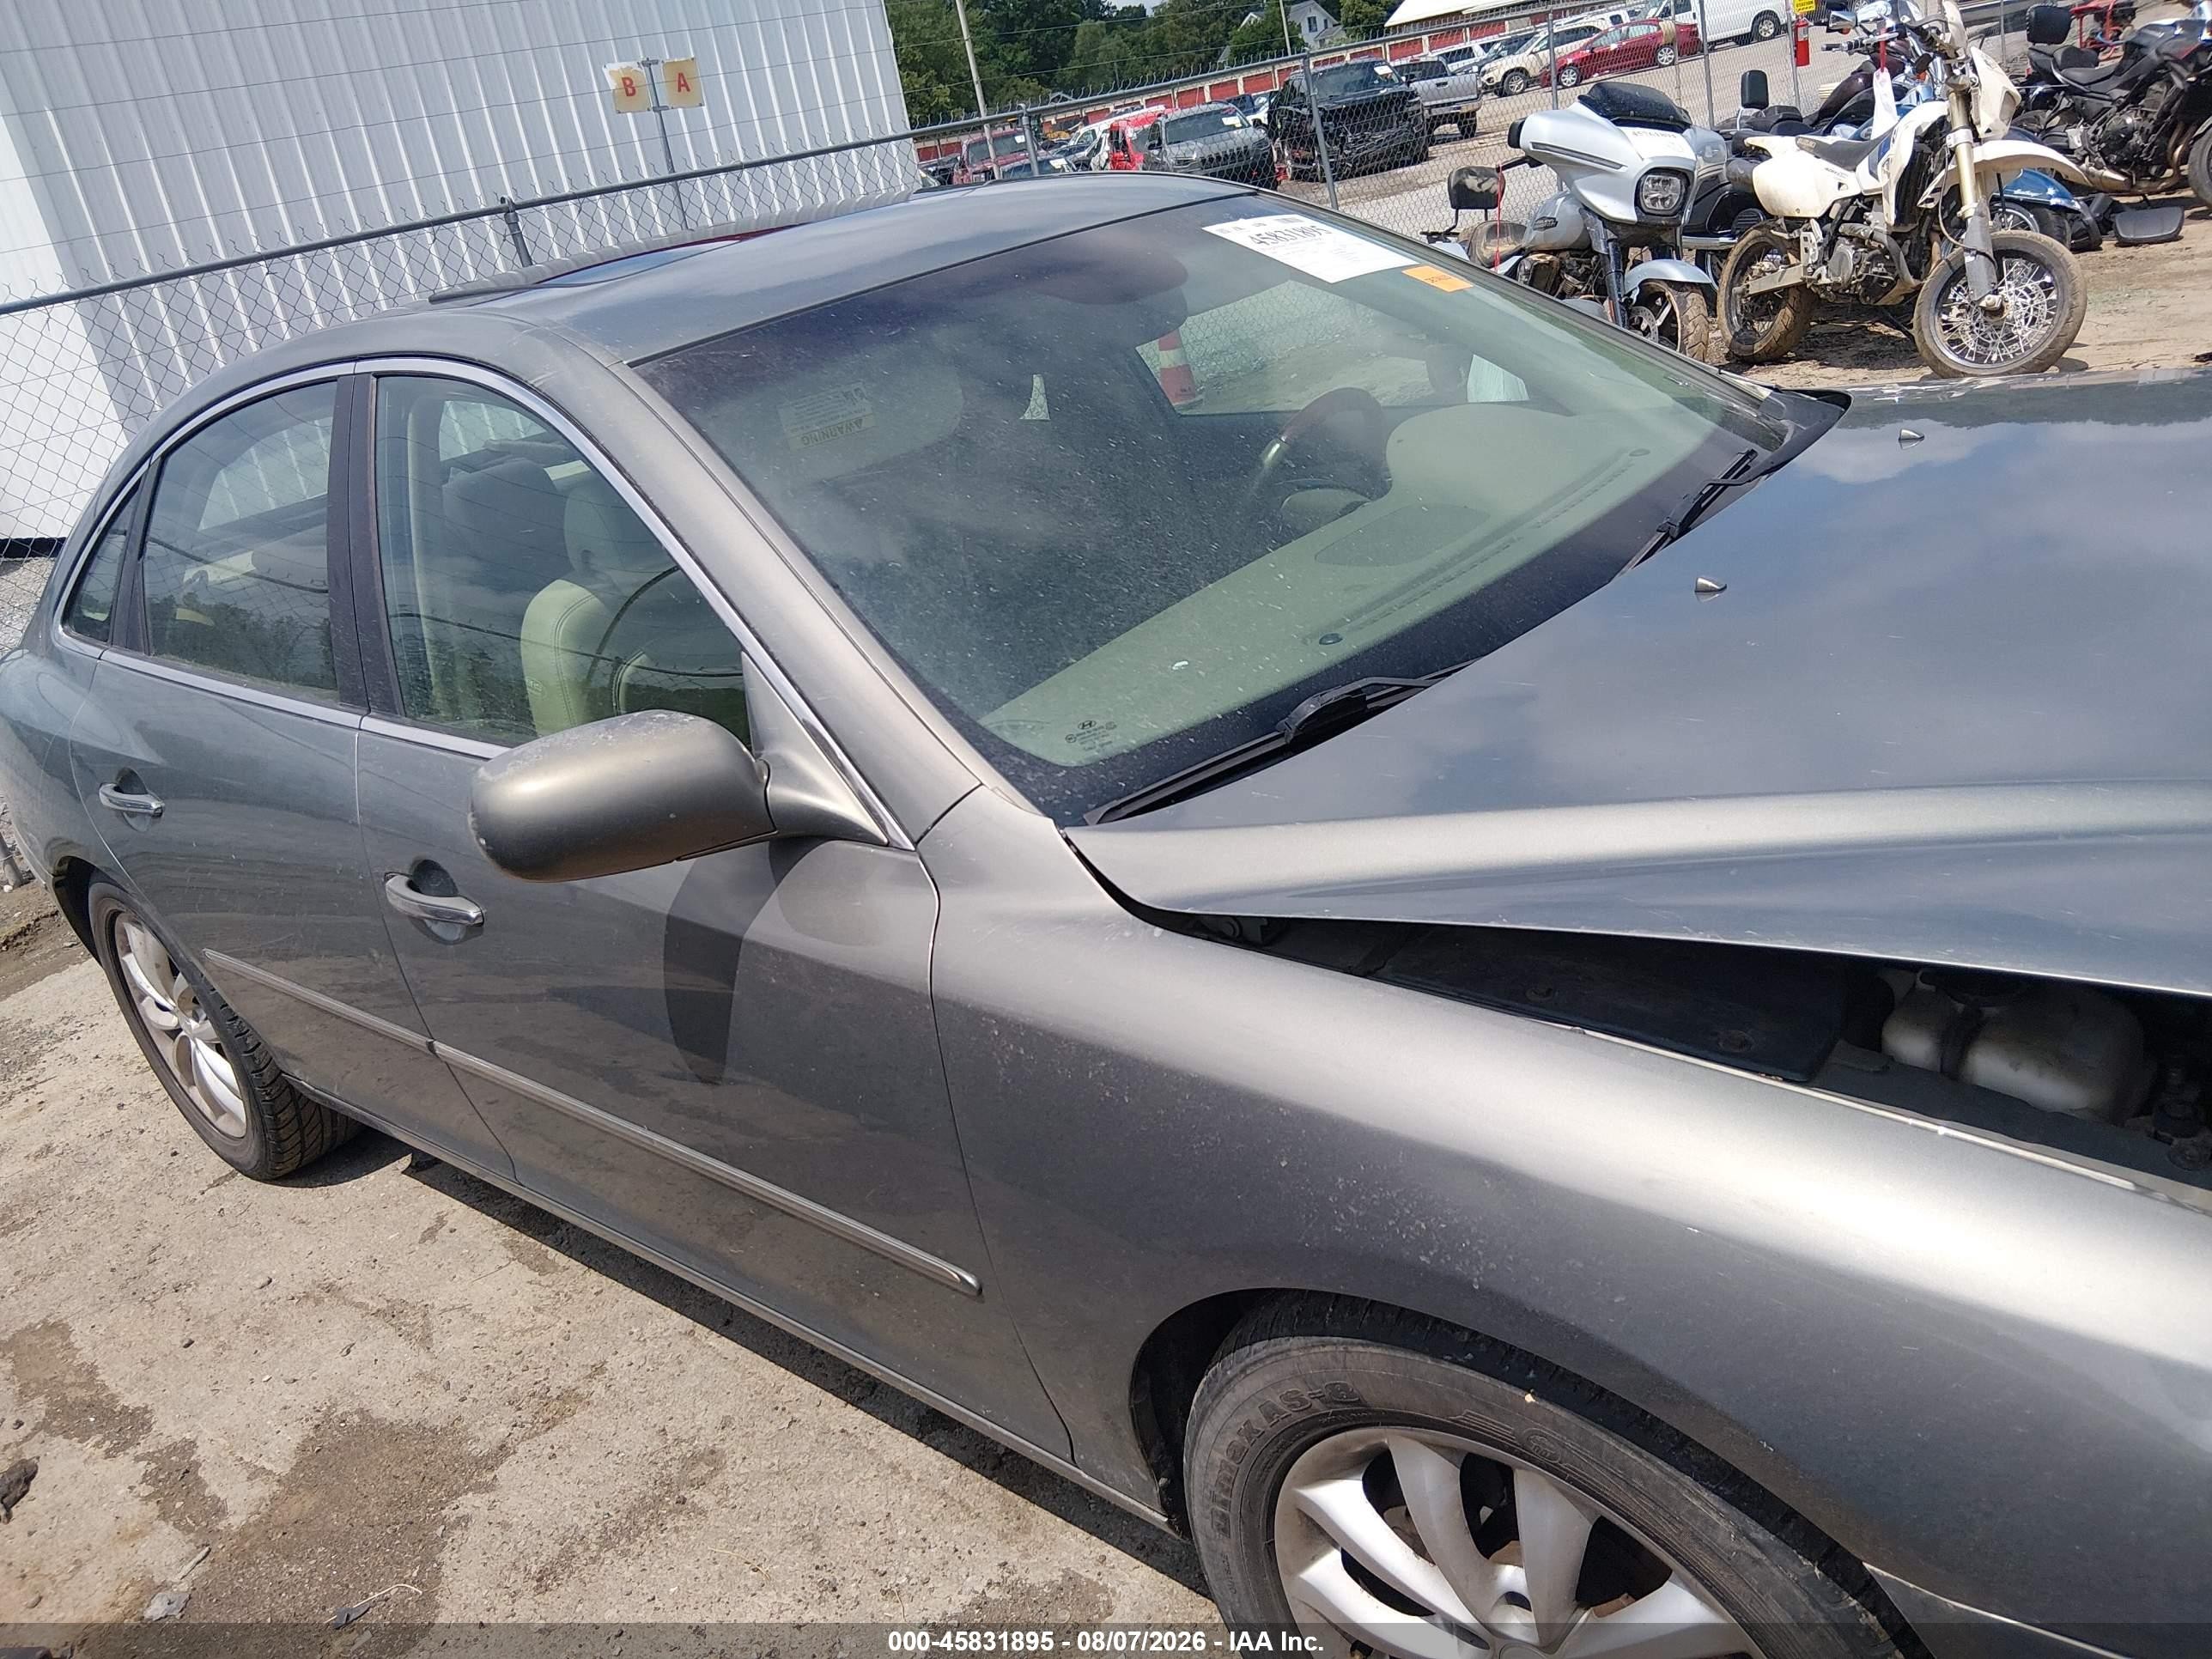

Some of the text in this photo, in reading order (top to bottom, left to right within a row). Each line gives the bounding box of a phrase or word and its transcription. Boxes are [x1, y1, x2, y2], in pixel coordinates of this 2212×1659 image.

[621, 76, 636, 97] B
[677, 71, 691, 93] A
[1249, 225, 1333, 246] 45831895
[801, 421, 855, 446] WARNING
